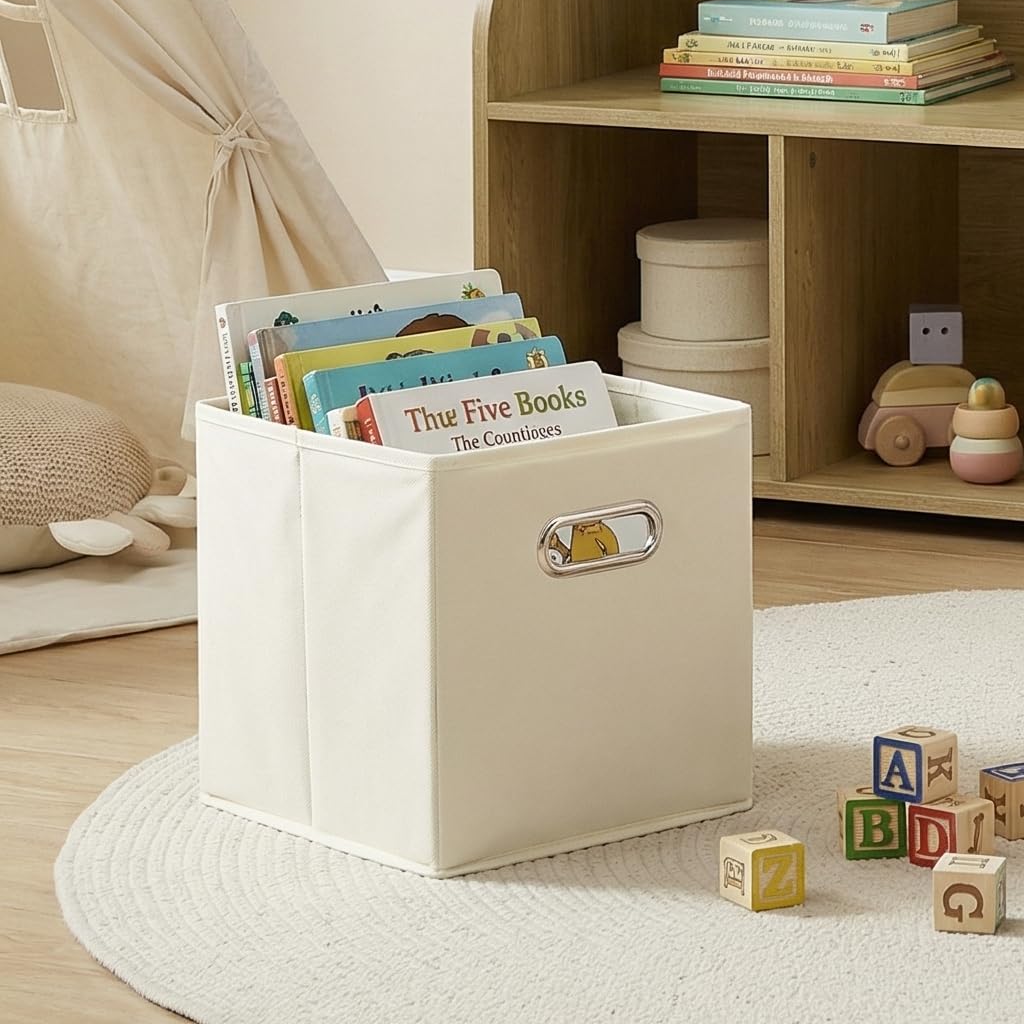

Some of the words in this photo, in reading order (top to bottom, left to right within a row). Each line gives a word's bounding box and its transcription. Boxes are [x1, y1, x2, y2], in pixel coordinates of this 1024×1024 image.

[461, 398, 513, 425] Five
[514, 385, 588, 416] Books
[451, 433, 480, 452] The
[880, 749, 915, 793] A
[859, 809, 894, 848] B
[915, 816, 949, 857] D
[943, 882, 984, 923] G
